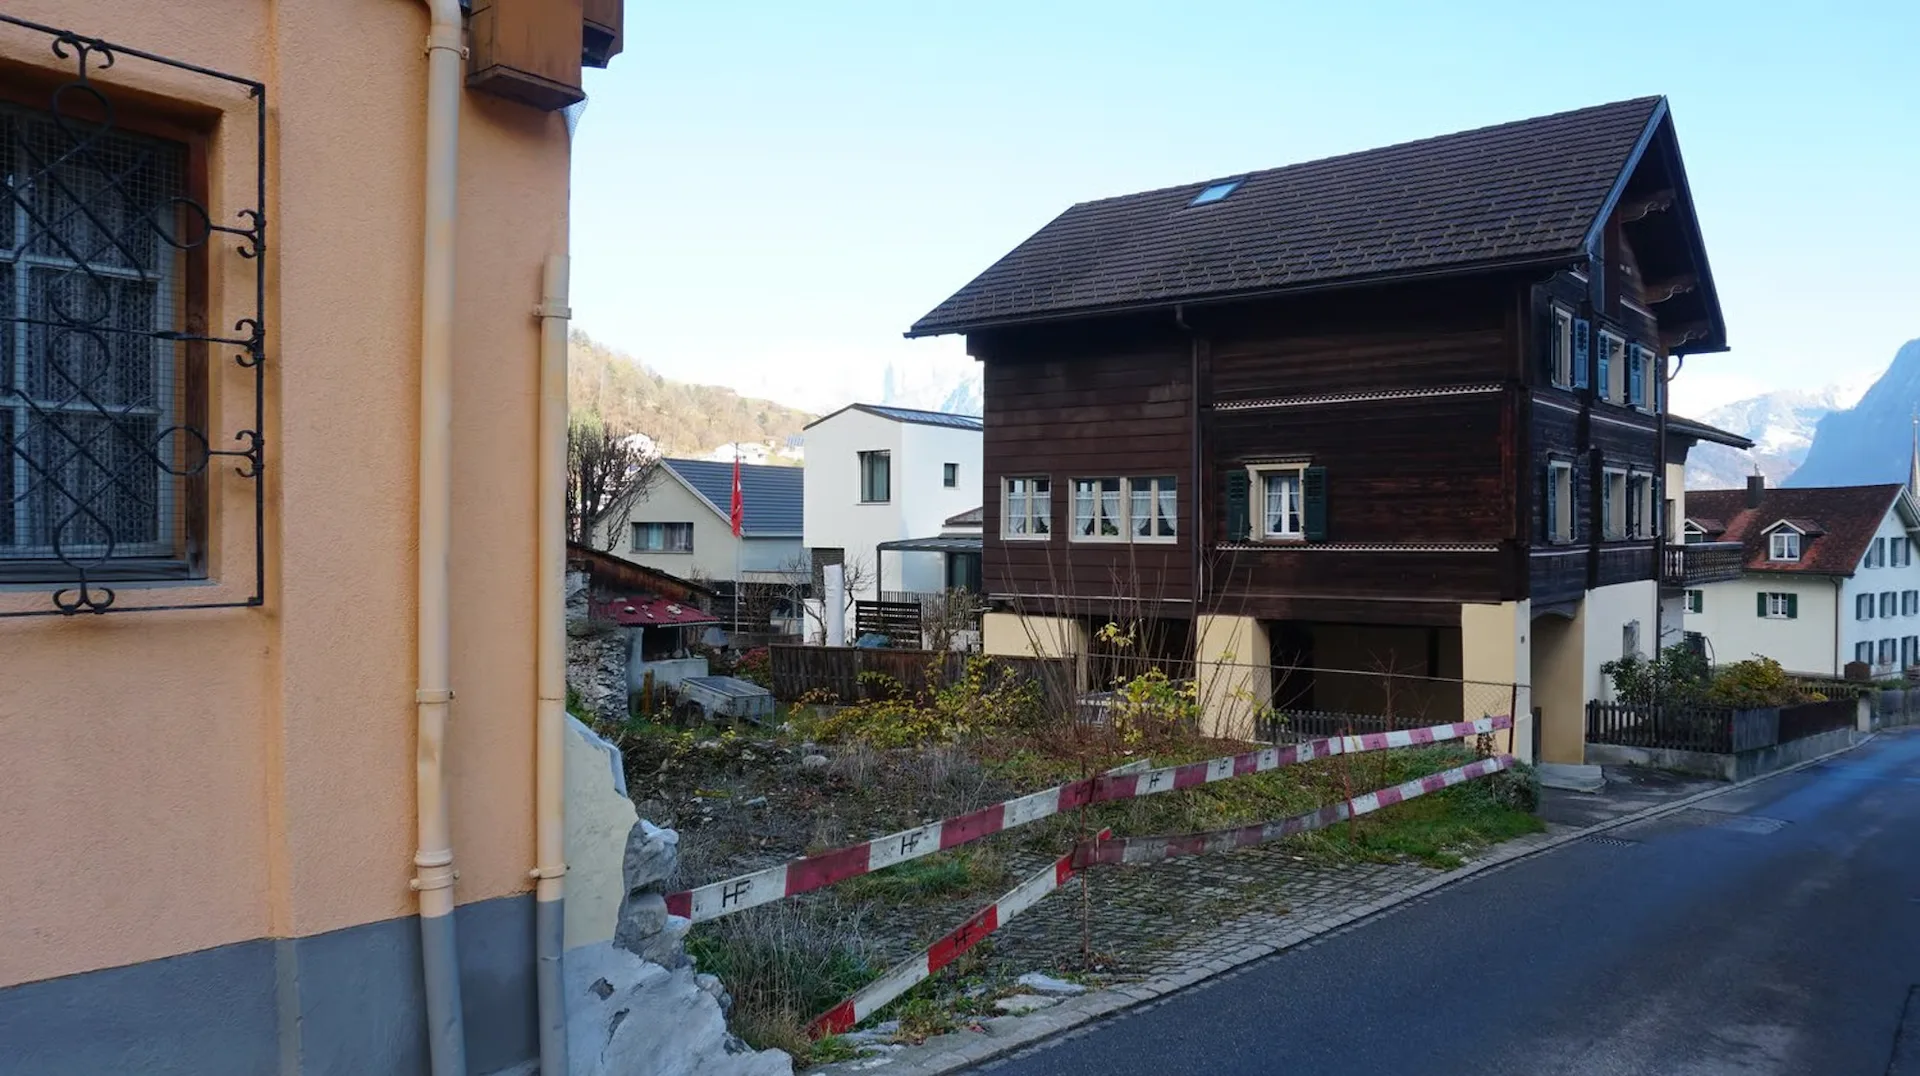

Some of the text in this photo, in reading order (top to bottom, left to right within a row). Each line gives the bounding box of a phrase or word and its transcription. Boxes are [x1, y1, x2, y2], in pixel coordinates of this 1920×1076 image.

[1149, 772, 1163, 788] HF
[901, 832, 922, 855] HF
[722, 880, 750, 907] HF
[954, 924, 972, 949] HF
